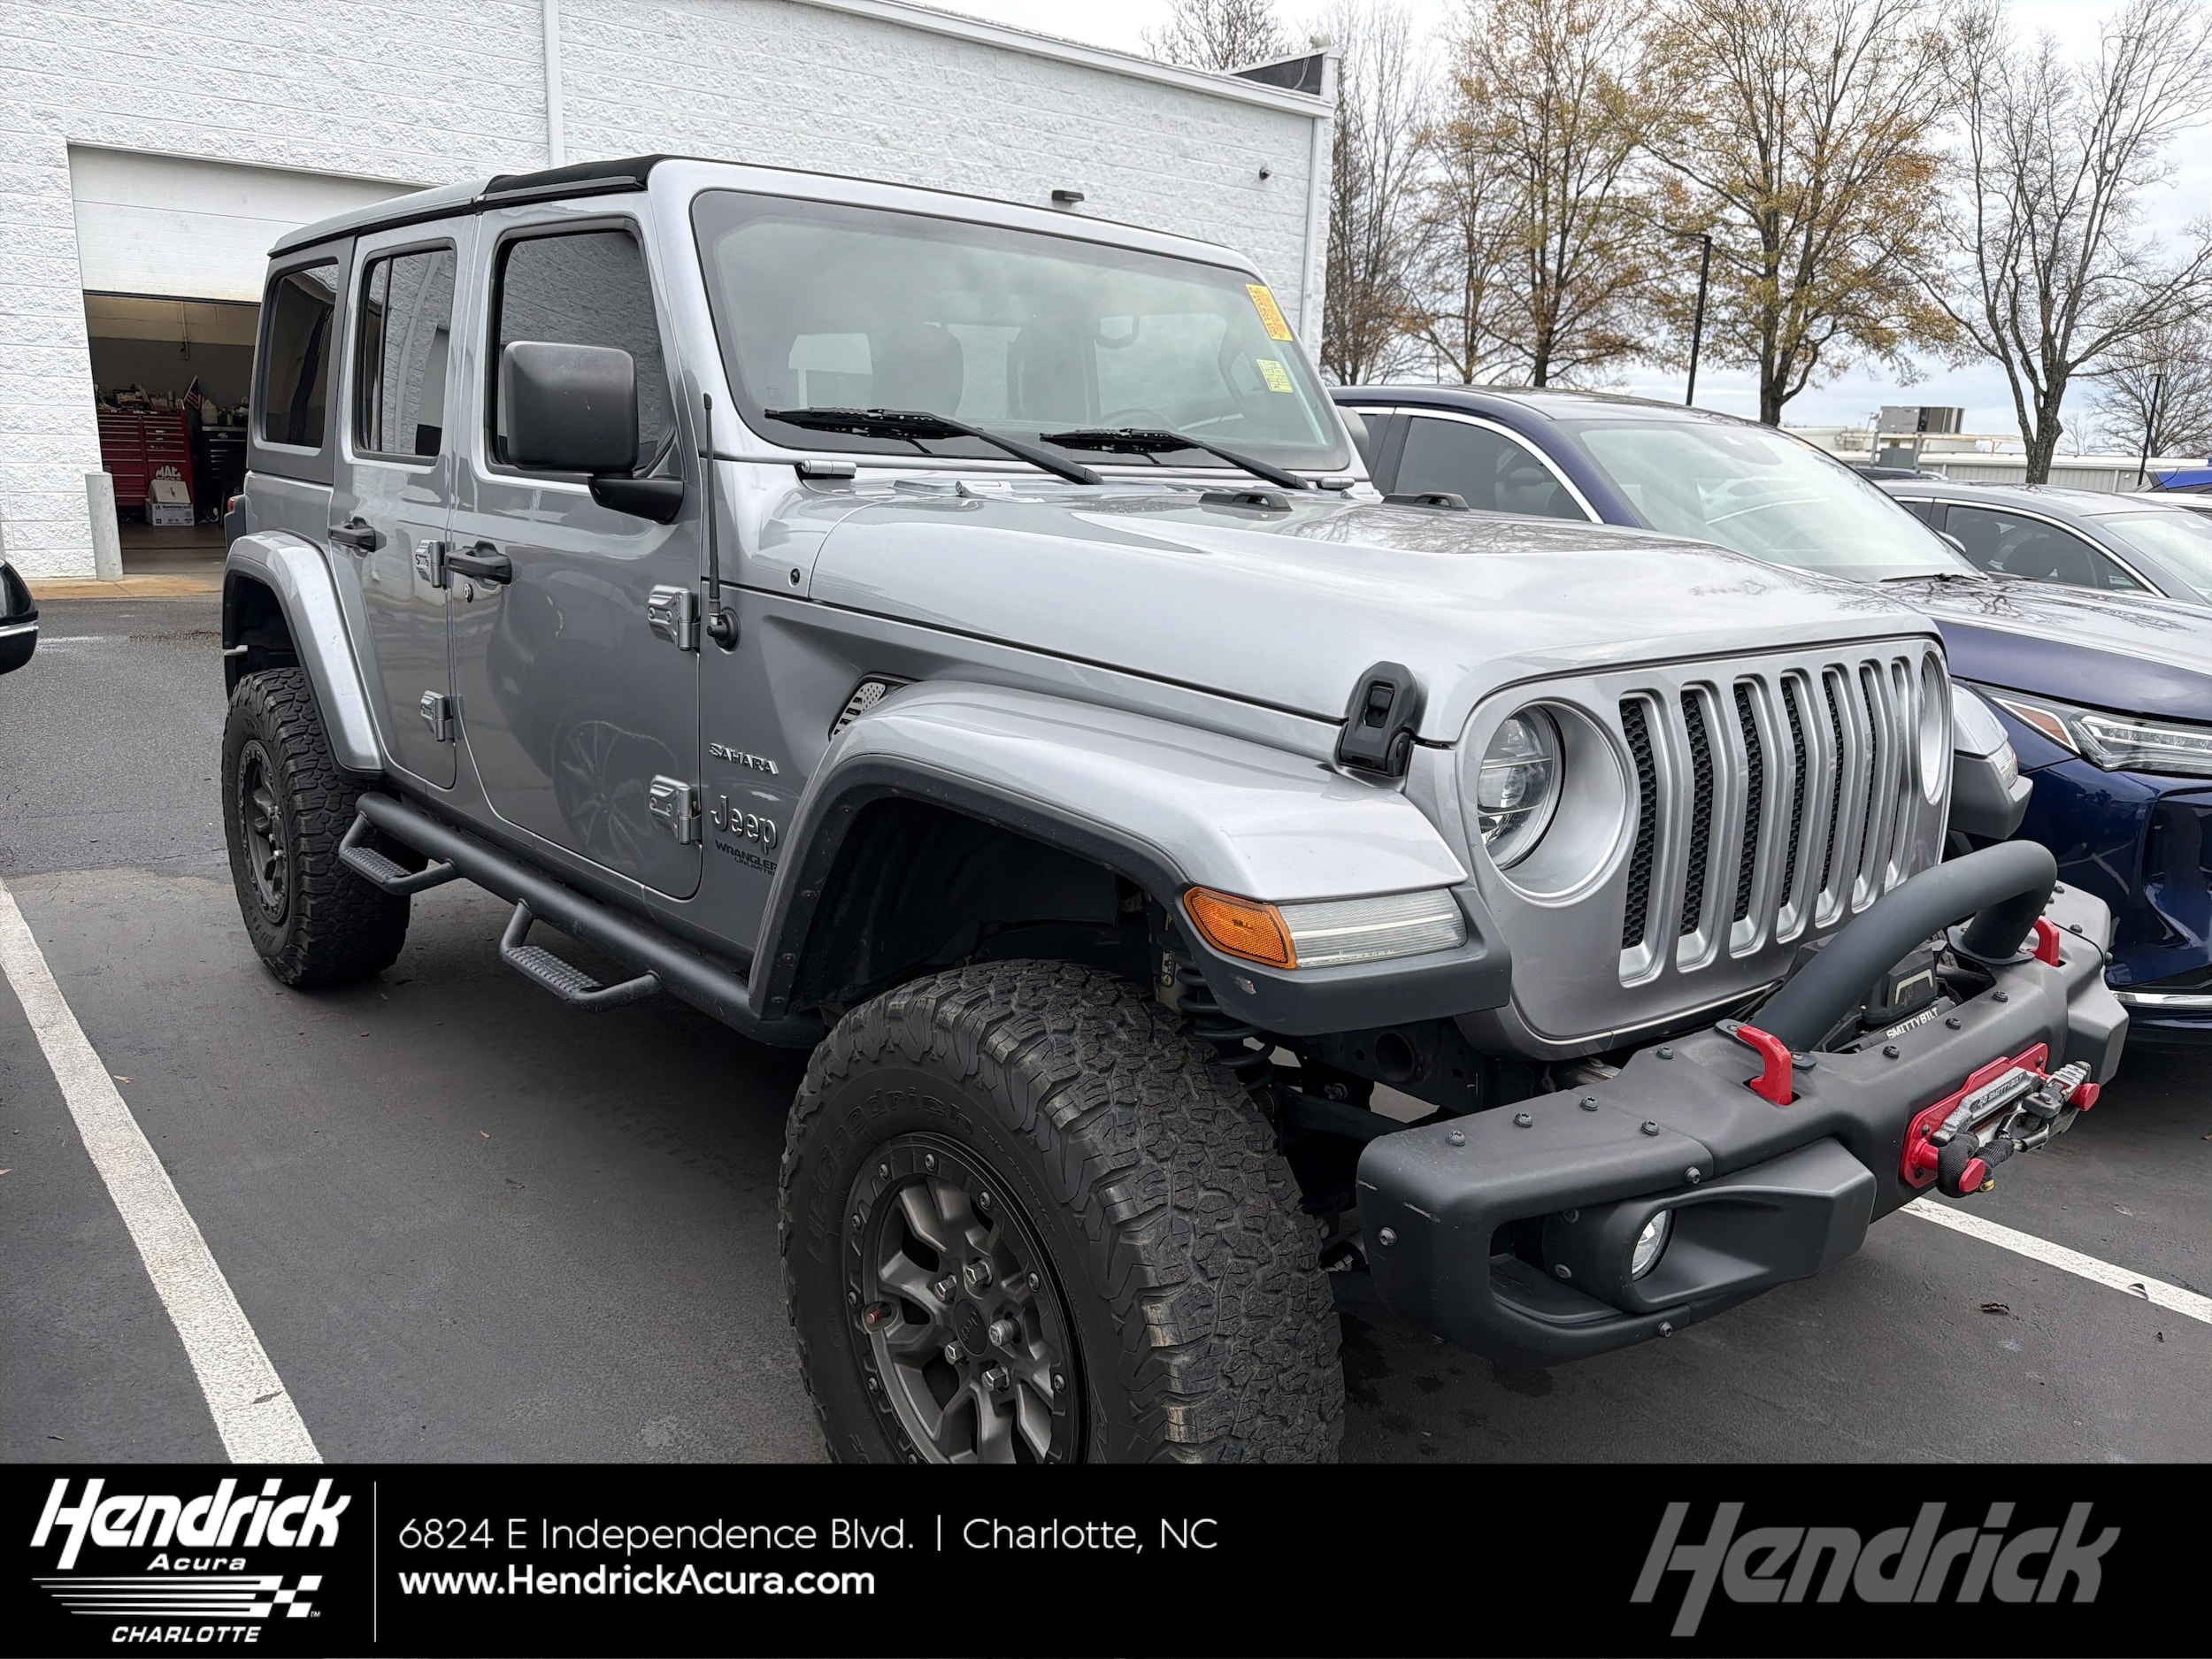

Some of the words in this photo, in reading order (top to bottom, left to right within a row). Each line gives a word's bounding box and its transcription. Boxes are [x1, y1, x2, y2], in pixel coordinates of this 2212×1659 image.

[709, 742, 779, 775] SAHARA
[710, 795, 778, 855] Jeep
[715, 840, 778, 871] WRANGLER
[1886, 1007, 1939, 1040] SMITTYBILT
